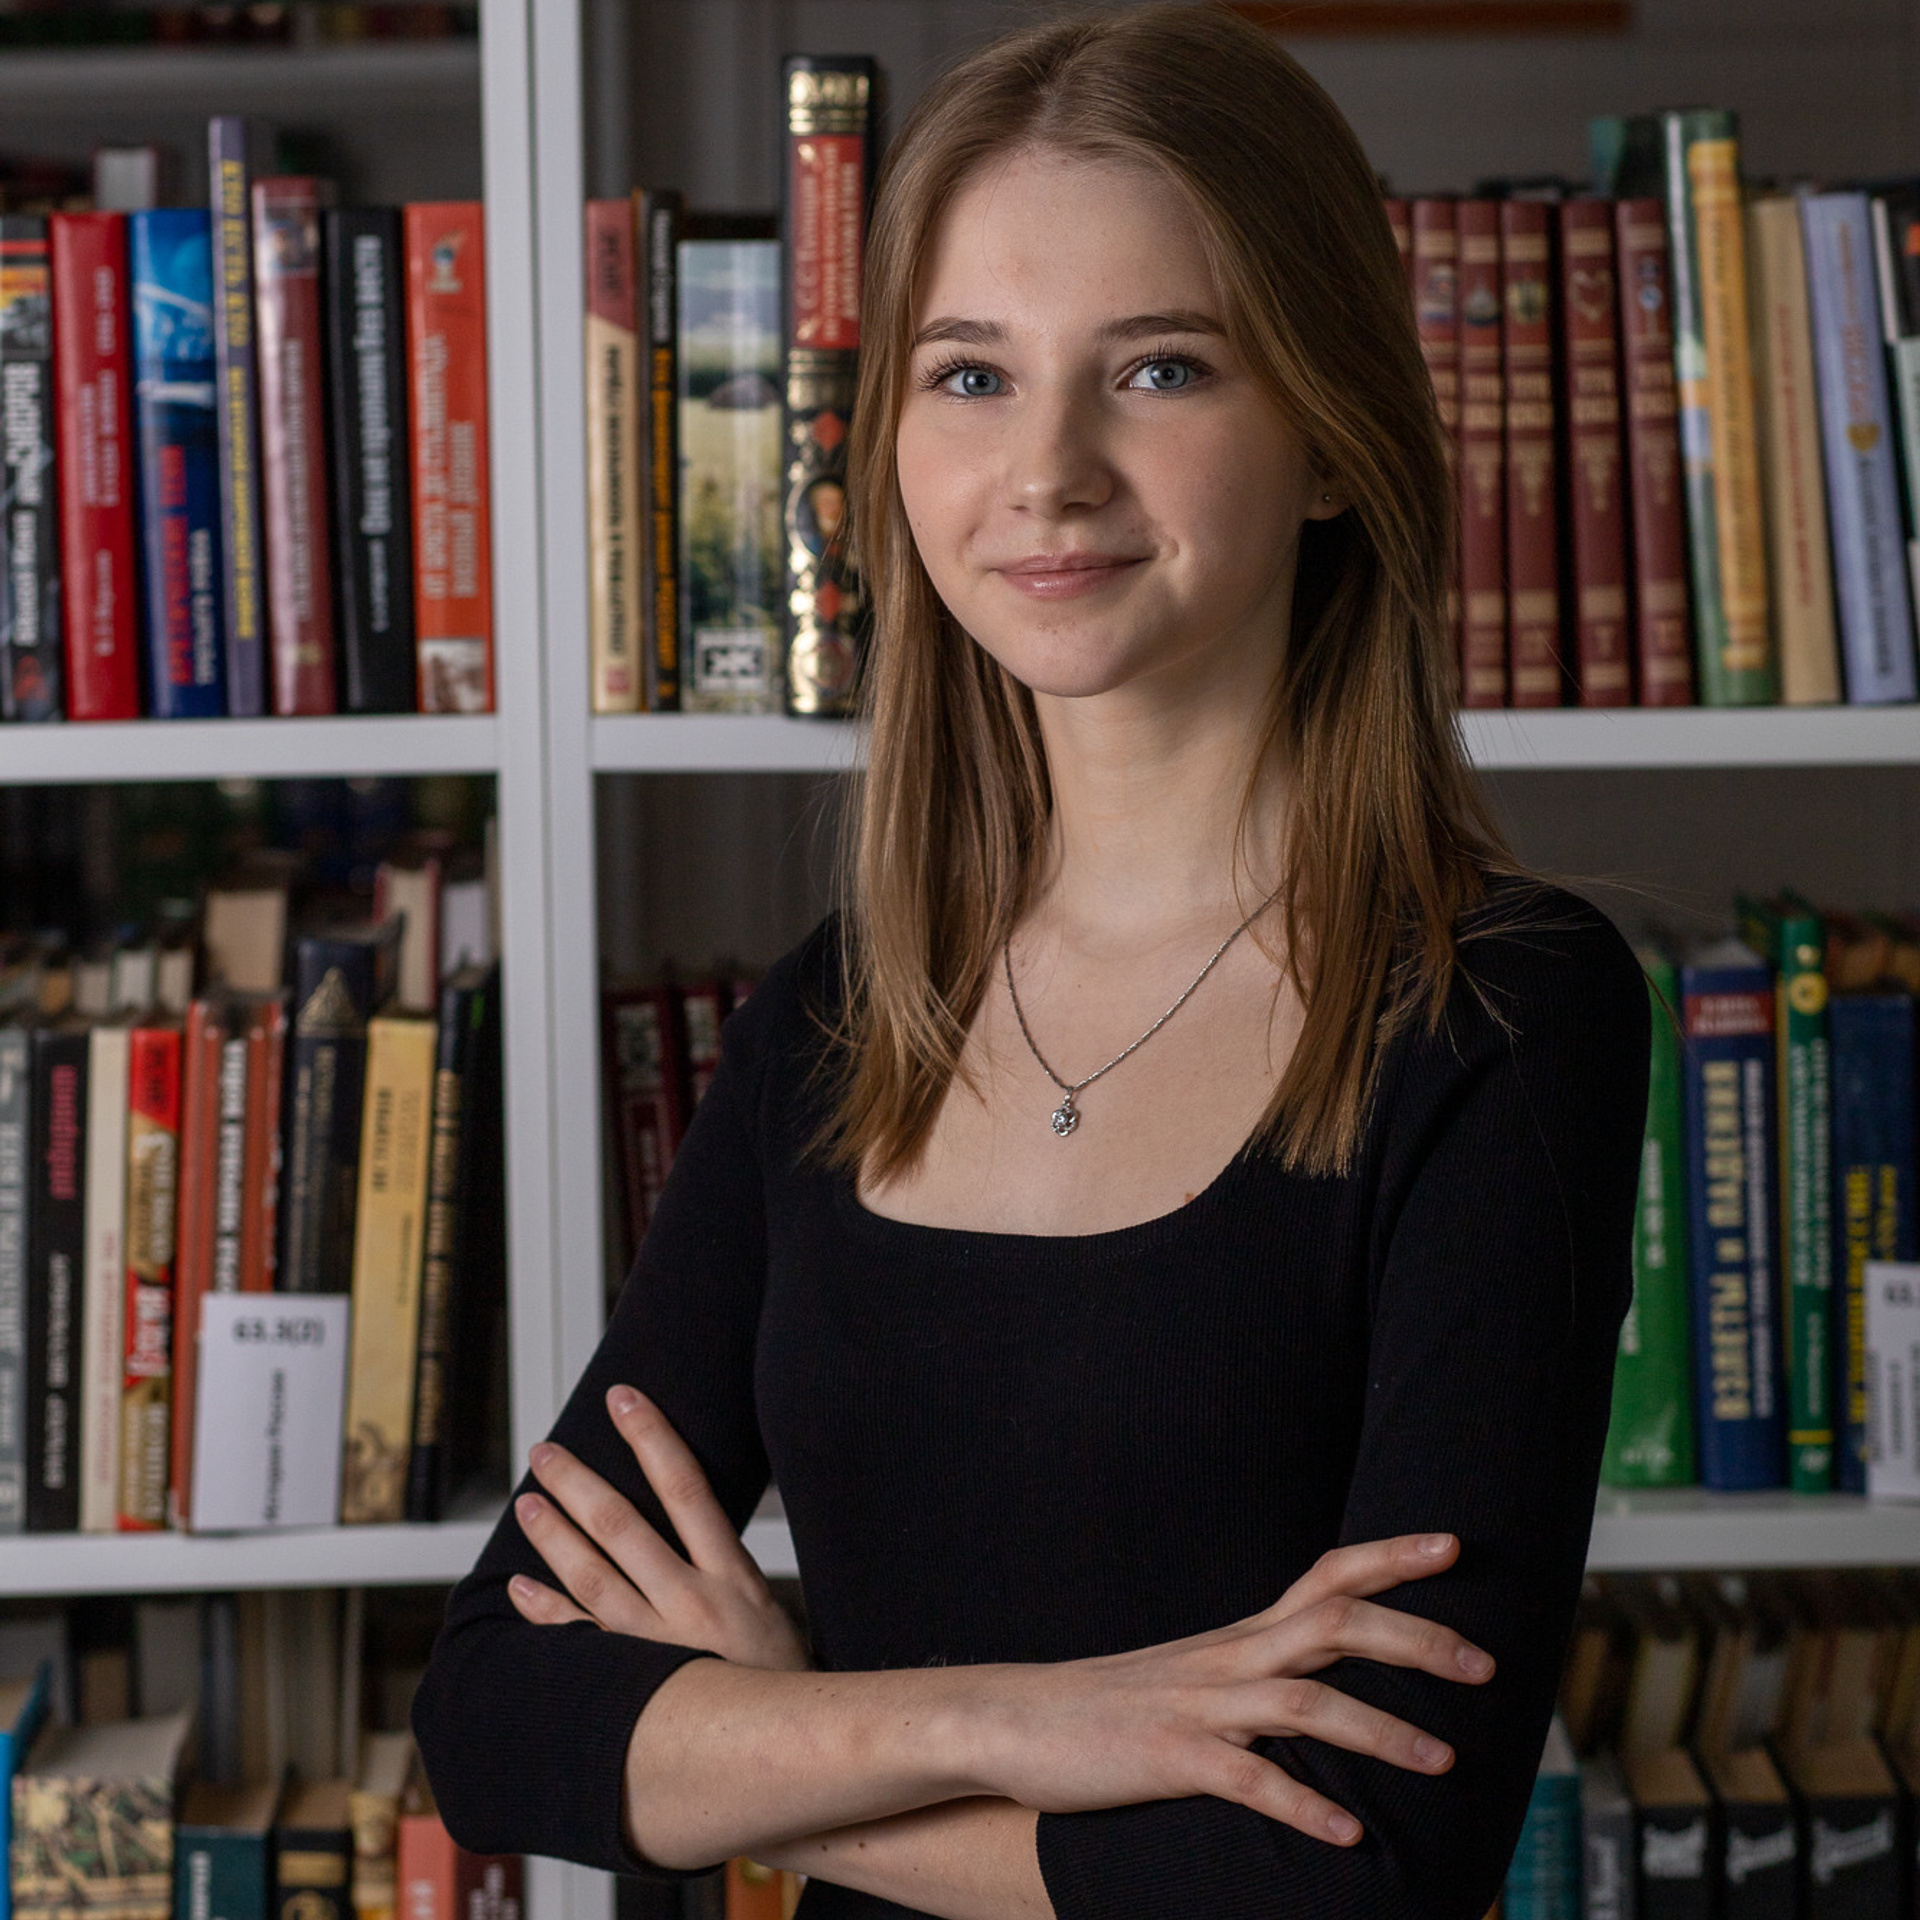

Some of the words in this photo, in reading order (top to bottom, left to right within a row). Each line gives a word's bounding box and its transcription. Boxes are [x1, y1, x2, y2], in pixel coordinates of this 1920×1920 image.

[352, 308, 384, 351] без
[357, 352, 392, 453] пропали
[1702, 1061, 1748, 1228] ПАДЕНИЯ
[1708, 1273, 1750, 1420] ВЗЛЕТЫ
